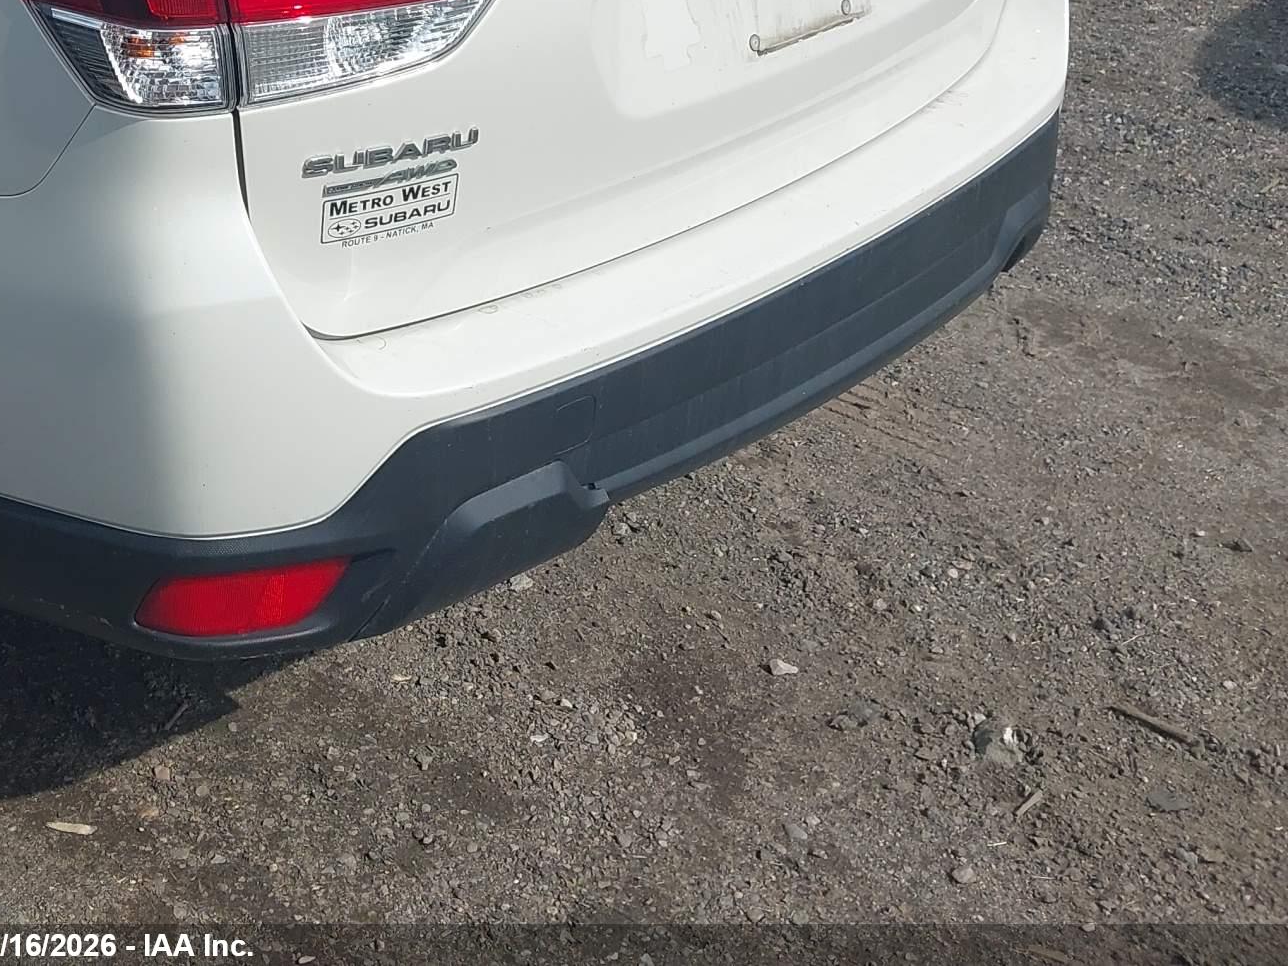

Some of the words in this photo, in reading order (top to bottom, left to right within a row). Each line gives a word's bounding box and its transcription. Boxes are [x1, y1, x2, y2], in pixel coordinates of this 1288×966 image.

[302, 126, 479, 178] SUBARU
[364, 200, 450, 229] SUBARU
[341, 235, 372, 249] ROUTE
[421, 221, 434, 230] MA
